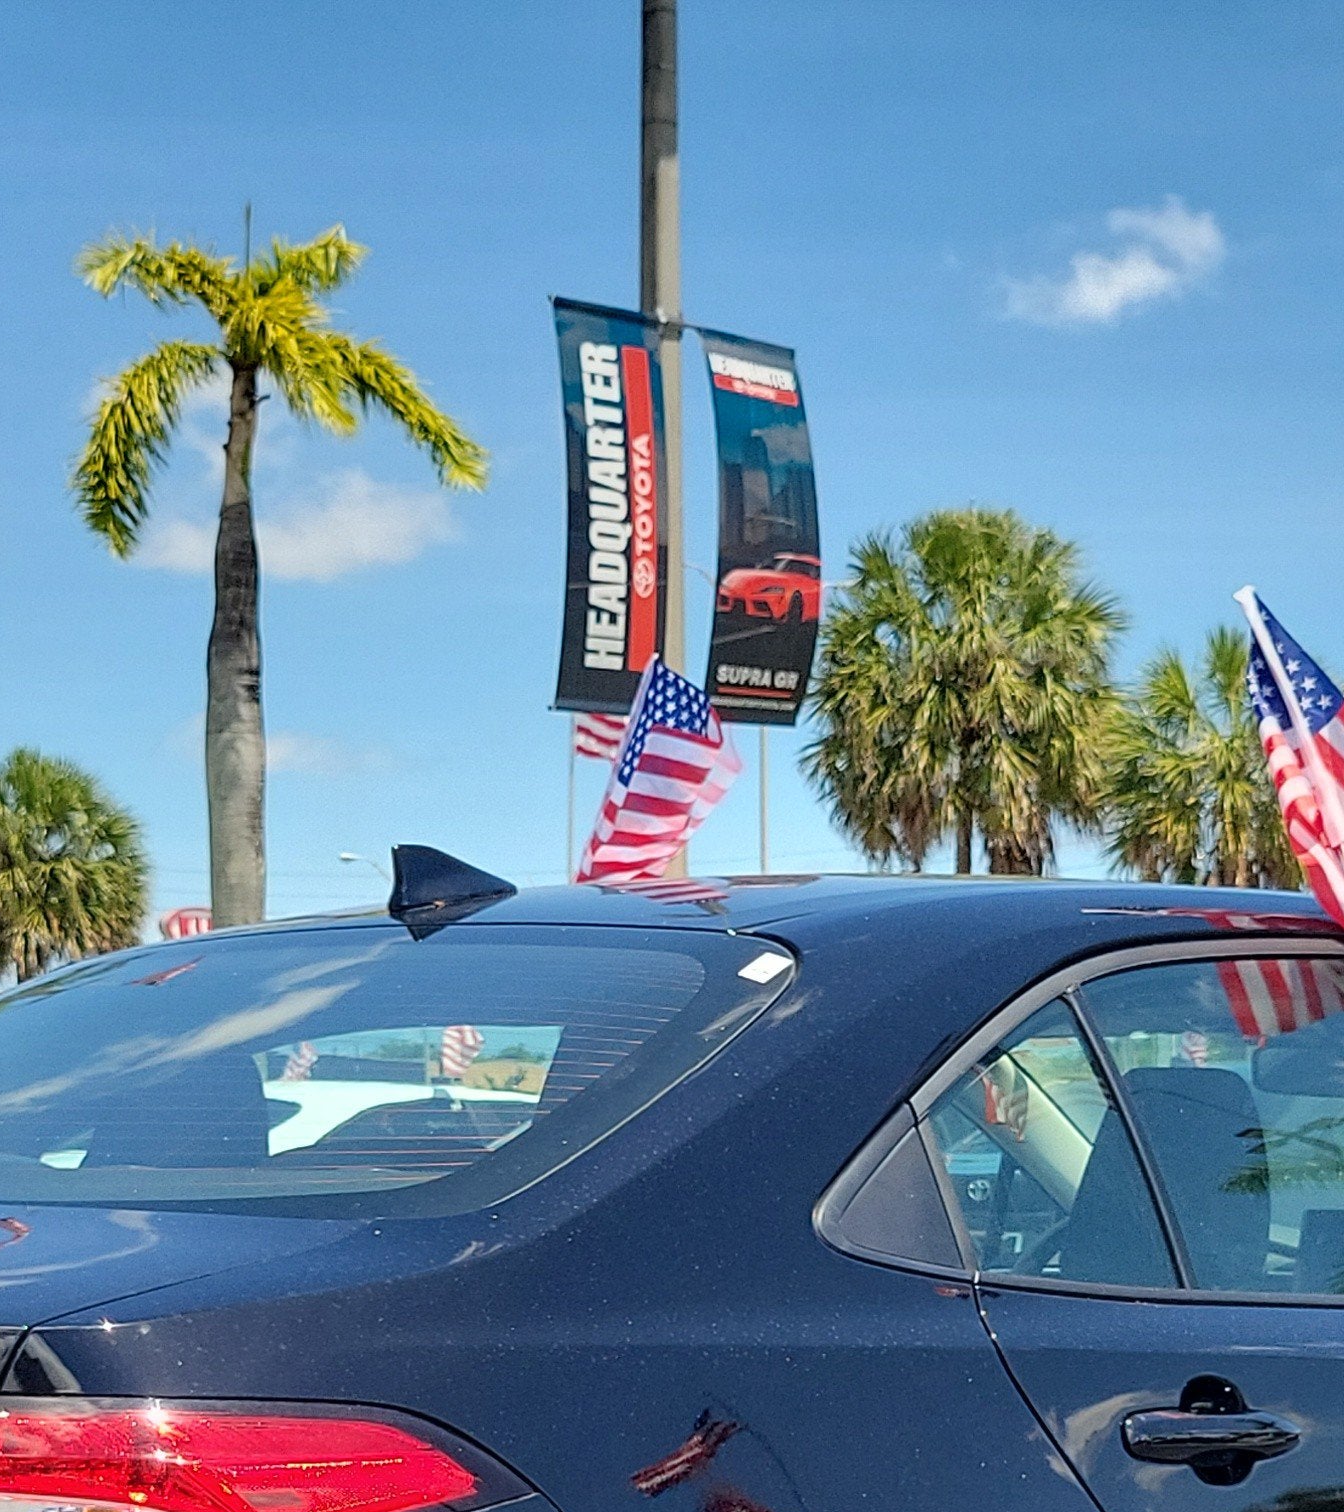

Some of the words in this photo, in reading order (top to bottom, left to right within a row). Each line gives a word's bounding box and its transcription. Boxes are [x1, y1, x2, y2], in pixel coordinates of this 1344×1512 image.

[578, 341, 633, 672] HEADQUARTER
[632, 433, 655, 558] TOYOTA
[716, 664, 772, 688] SUPRA
